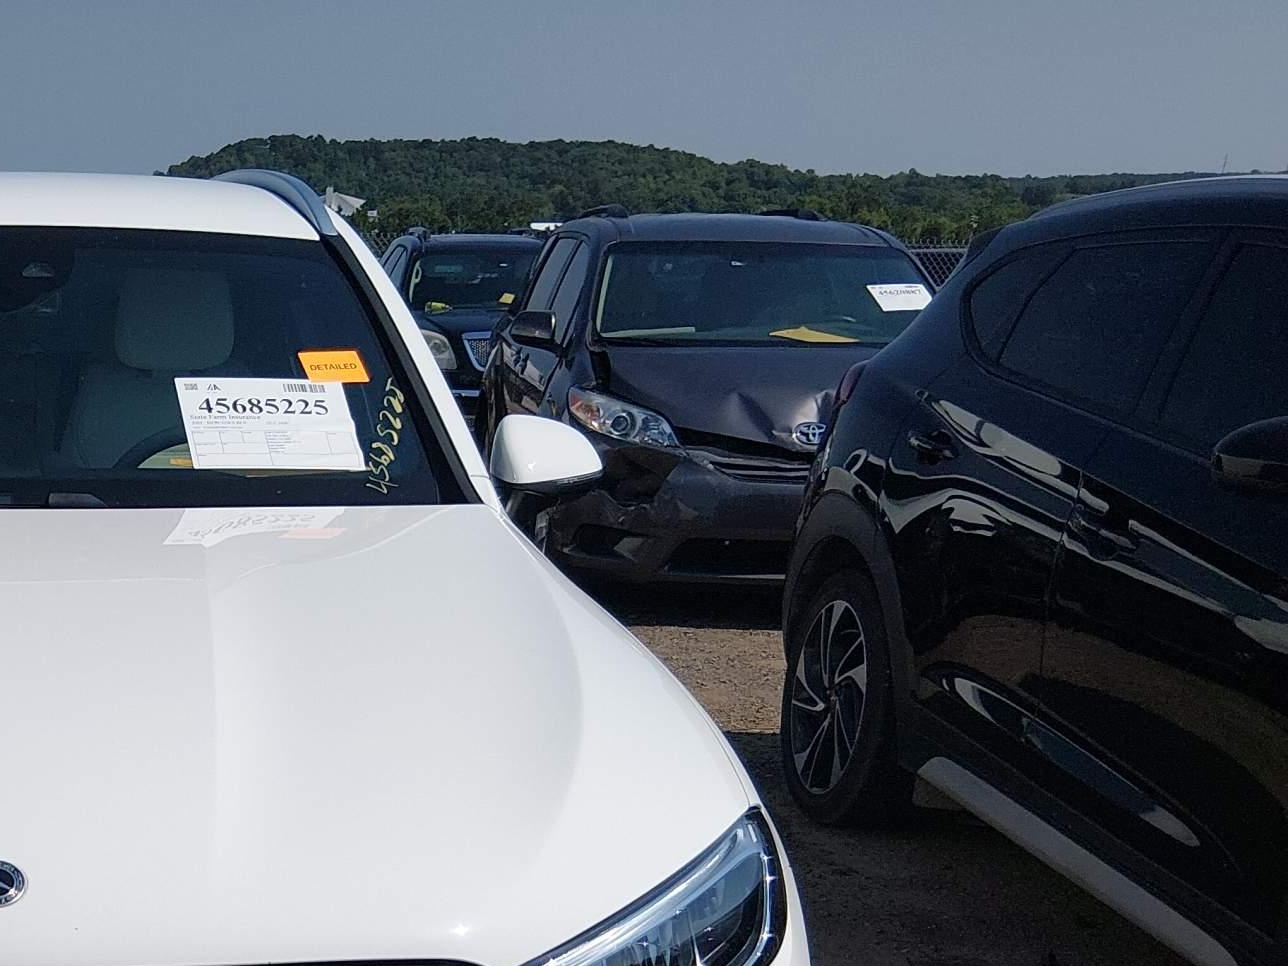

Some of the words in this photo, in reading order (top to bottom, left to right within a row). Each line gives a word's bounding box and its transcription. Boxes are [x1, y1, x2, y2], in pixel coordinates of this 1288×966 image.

[309, 363, 358, 371] DETAILED
[198, 397, 329, 416] 45685225
[365, 376, 405, 495] 45685225
